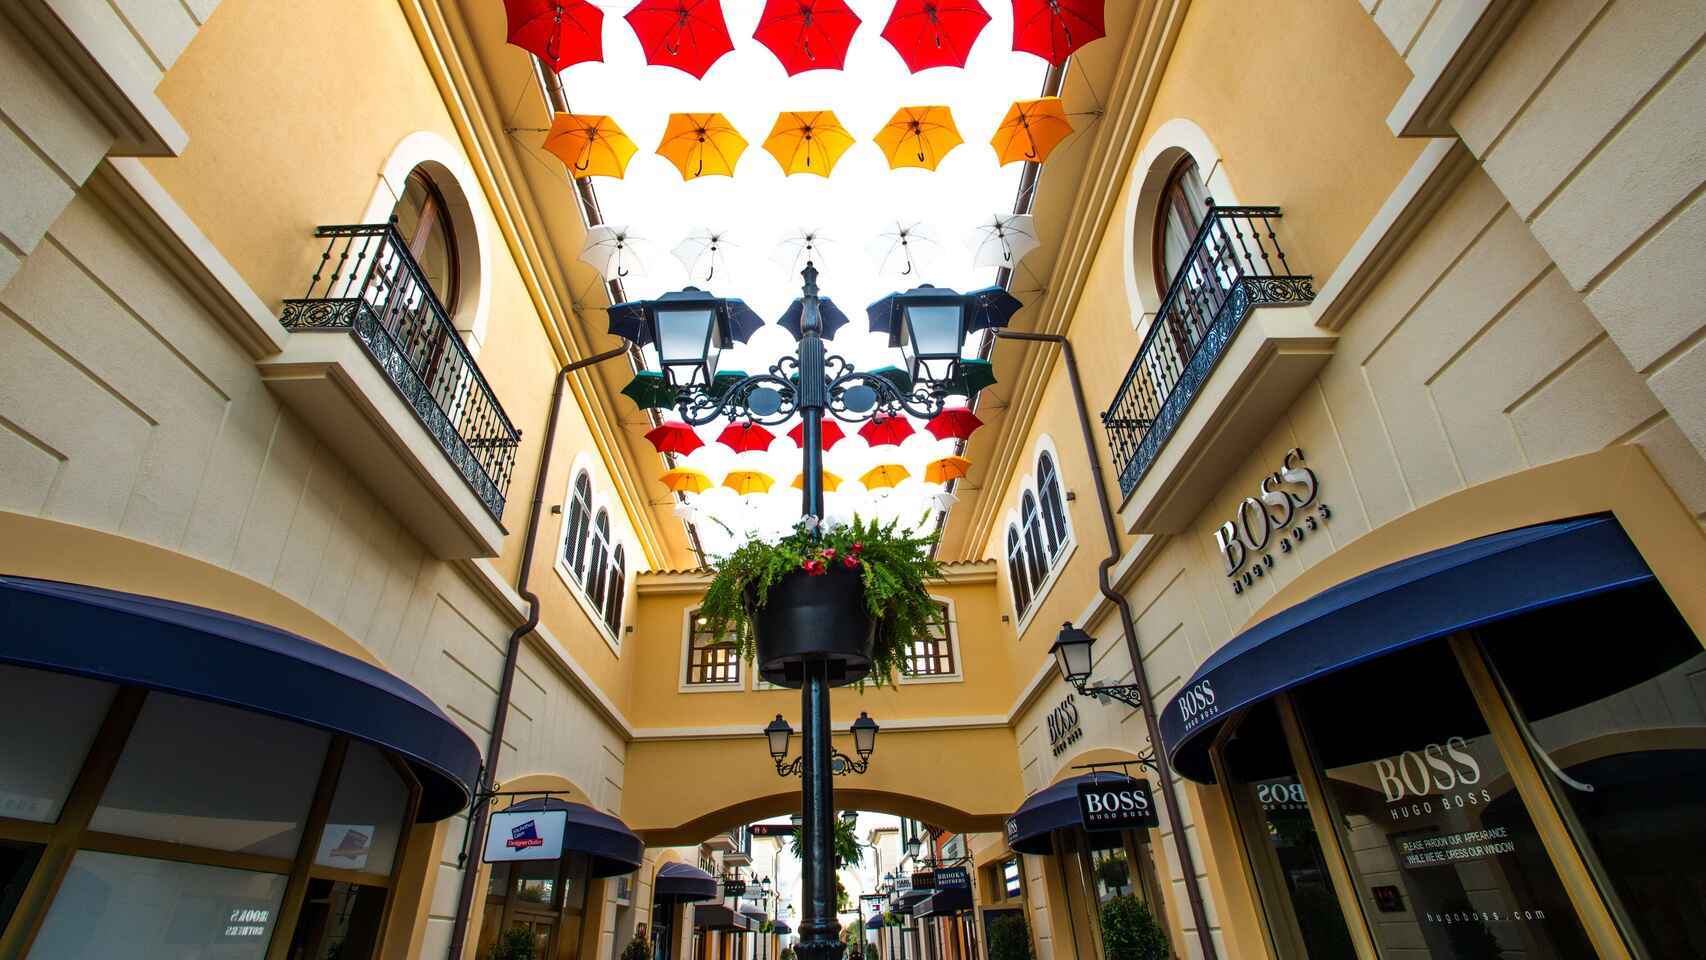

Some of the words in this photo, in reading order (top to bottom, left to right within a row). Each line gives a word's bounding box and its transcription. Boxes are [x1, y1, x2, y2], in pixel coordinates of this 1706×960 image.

[1214, 447, 1318, 578] BOSS
[1233, 553, 1274, 594] HUGO
[1280, 504, 1332, 553] BOSS
[1047, 694, 1078, 745] BOSS
[1178, 680, 1214, 721] BOSS
[1374, 736, 1481, 803] BOSS
[1085, 790, 1148, 813] BOSS
[1390, 802, 1432, 820] HUGO
[1442, 789, 1491, 810] BOSS
[1463, 827, 1507, 842] APPEARANCE
